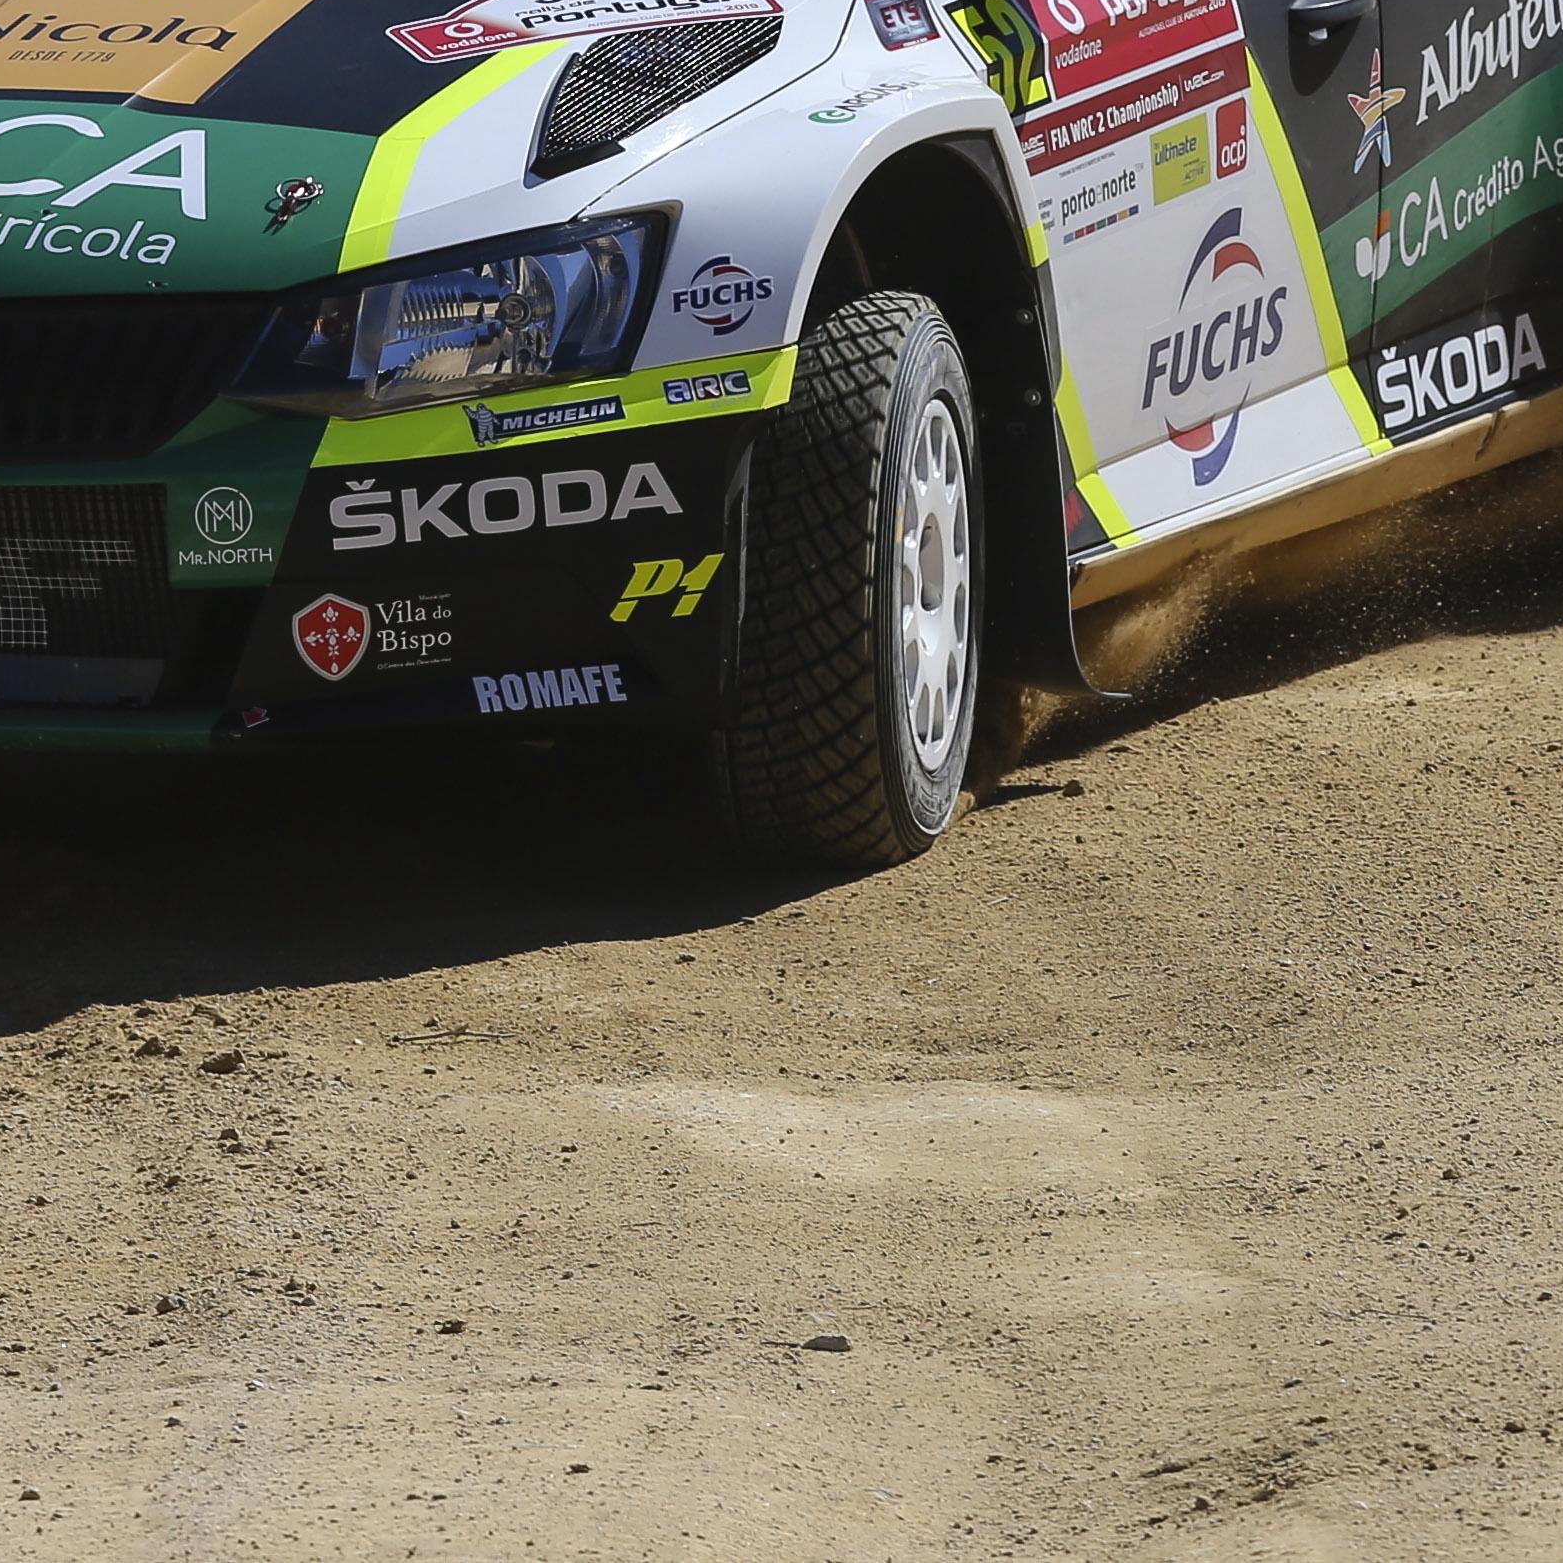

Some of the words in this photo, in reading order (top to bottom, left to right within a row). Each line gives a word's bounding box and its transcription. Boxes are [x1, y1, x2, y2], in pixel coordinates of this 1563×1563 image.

[515, 3, 566, 18] rally
[9, 48, 65, 64] DESDE
[70, 49, 118, 65] 1779
[436, 31, 517, 52] vodafone
[1055, 38, 1103, 70] vodafone
[1050, 124, 1067, 152] FIA
[1070, 115, 1096, 146] WRC
[1097, 112, 1106, 134] 2
[1106, 83, 1180, 131] Championship
[1154, 135, 1197, 166] ultimate
[1398, 175, 1450, 268] CA
[1453, 155, 1525, 225] Crédito
[672, 274, 773, 314] FUCHS
[1141, 286, 1288, 411] FUCHS
[1375, 312, 1547, 431] ŠKODA
[501, 401, 617, 431] MICHELIN
[329, 462, 683, 551] ŠKODA
[609, 553, 725, 622] P1
[375, 600, 427, 625] Vila
[432, 605, 452, 619] do
[376, 629, 452, 656] Bispo
[472, 664, 628, 714] ROMAFE
